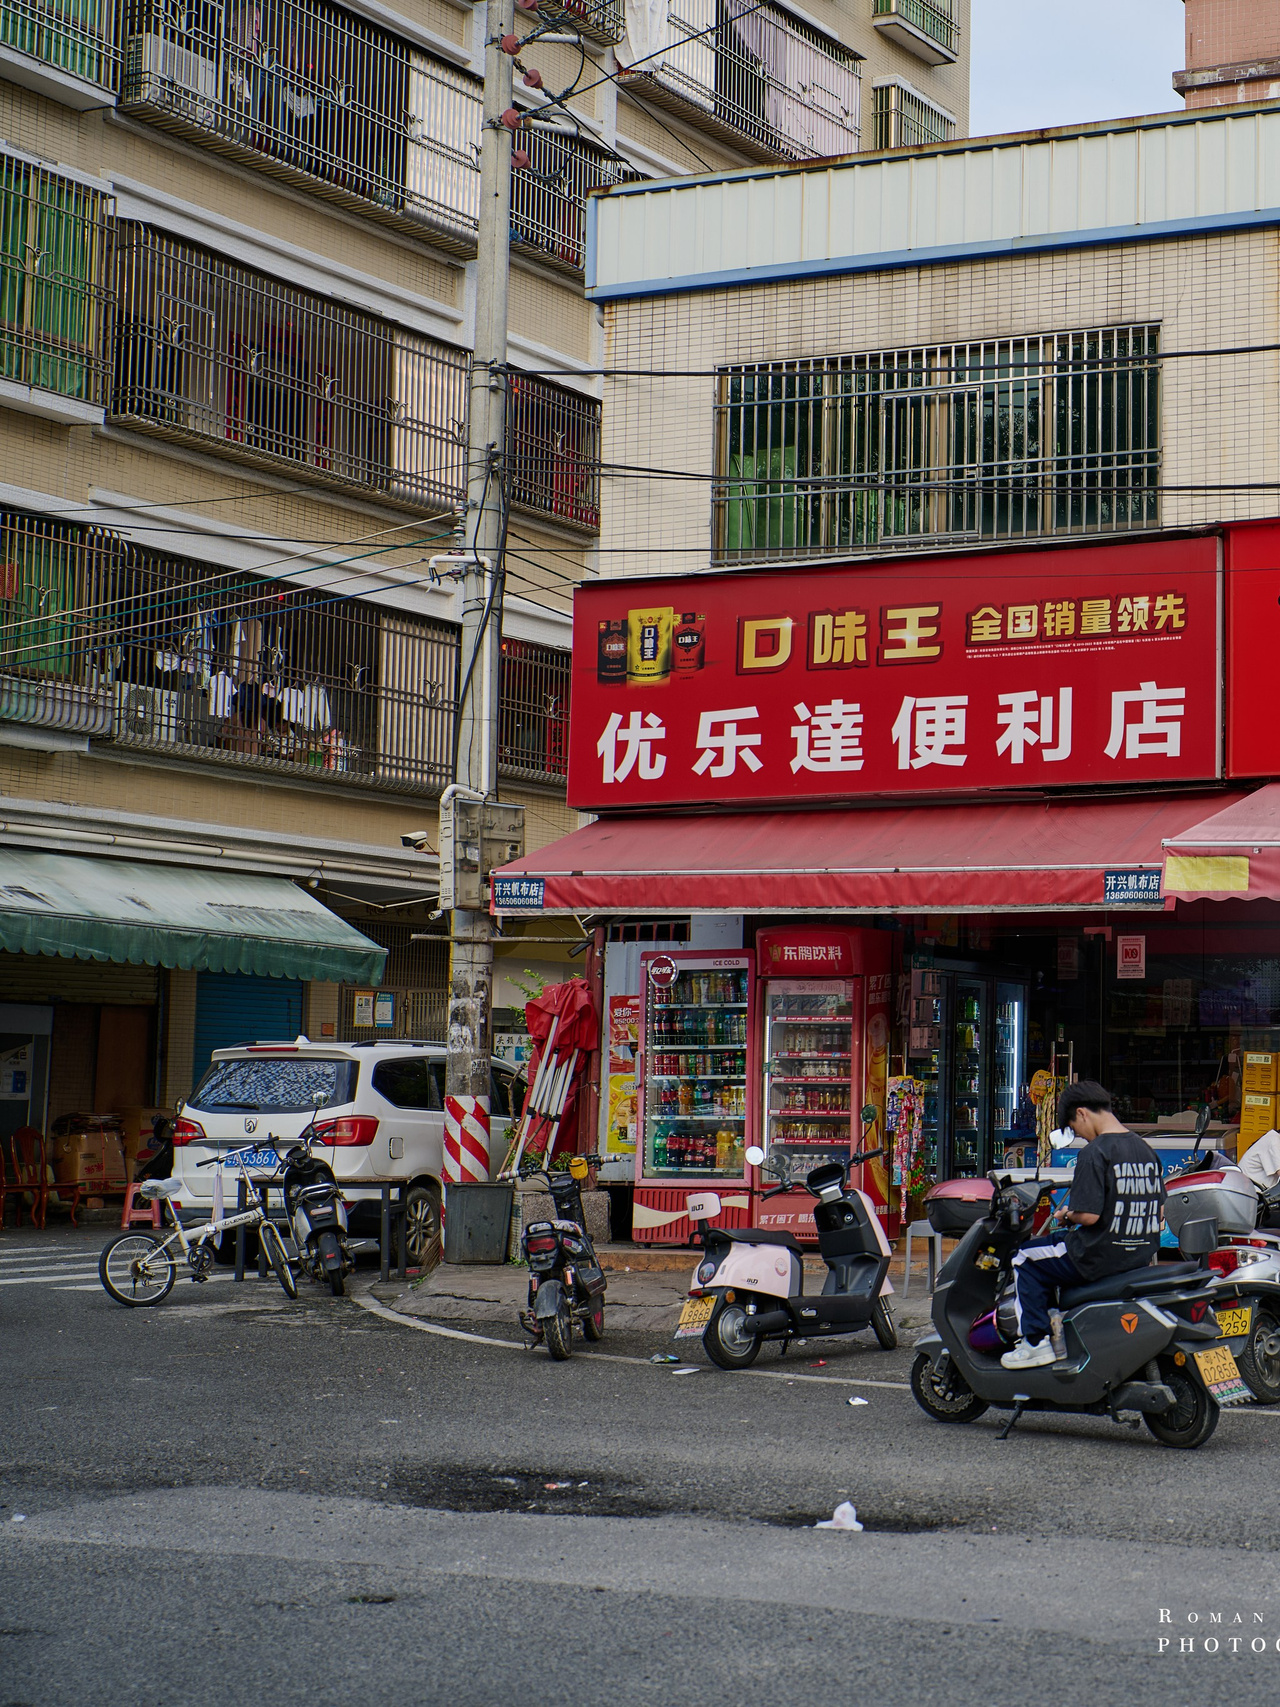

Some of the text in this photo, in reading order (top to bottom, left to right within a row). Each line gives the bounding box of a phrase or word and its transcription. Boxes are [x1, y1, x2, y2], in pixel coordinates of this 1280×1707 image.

[970, 593, 1187, 642] 全国销量领先
[742, 606, 941, 669] 口味王
[597, 681, 1186, 784] 优乐達便利店
[494, 882, 540, 897] 开兴帆布店
[1105, 875, 1160, 890] 开兴帆布店
[783, 946, 843, 960] 东鹏饮料
[759, 1214, 795, 1225] 累了困了
